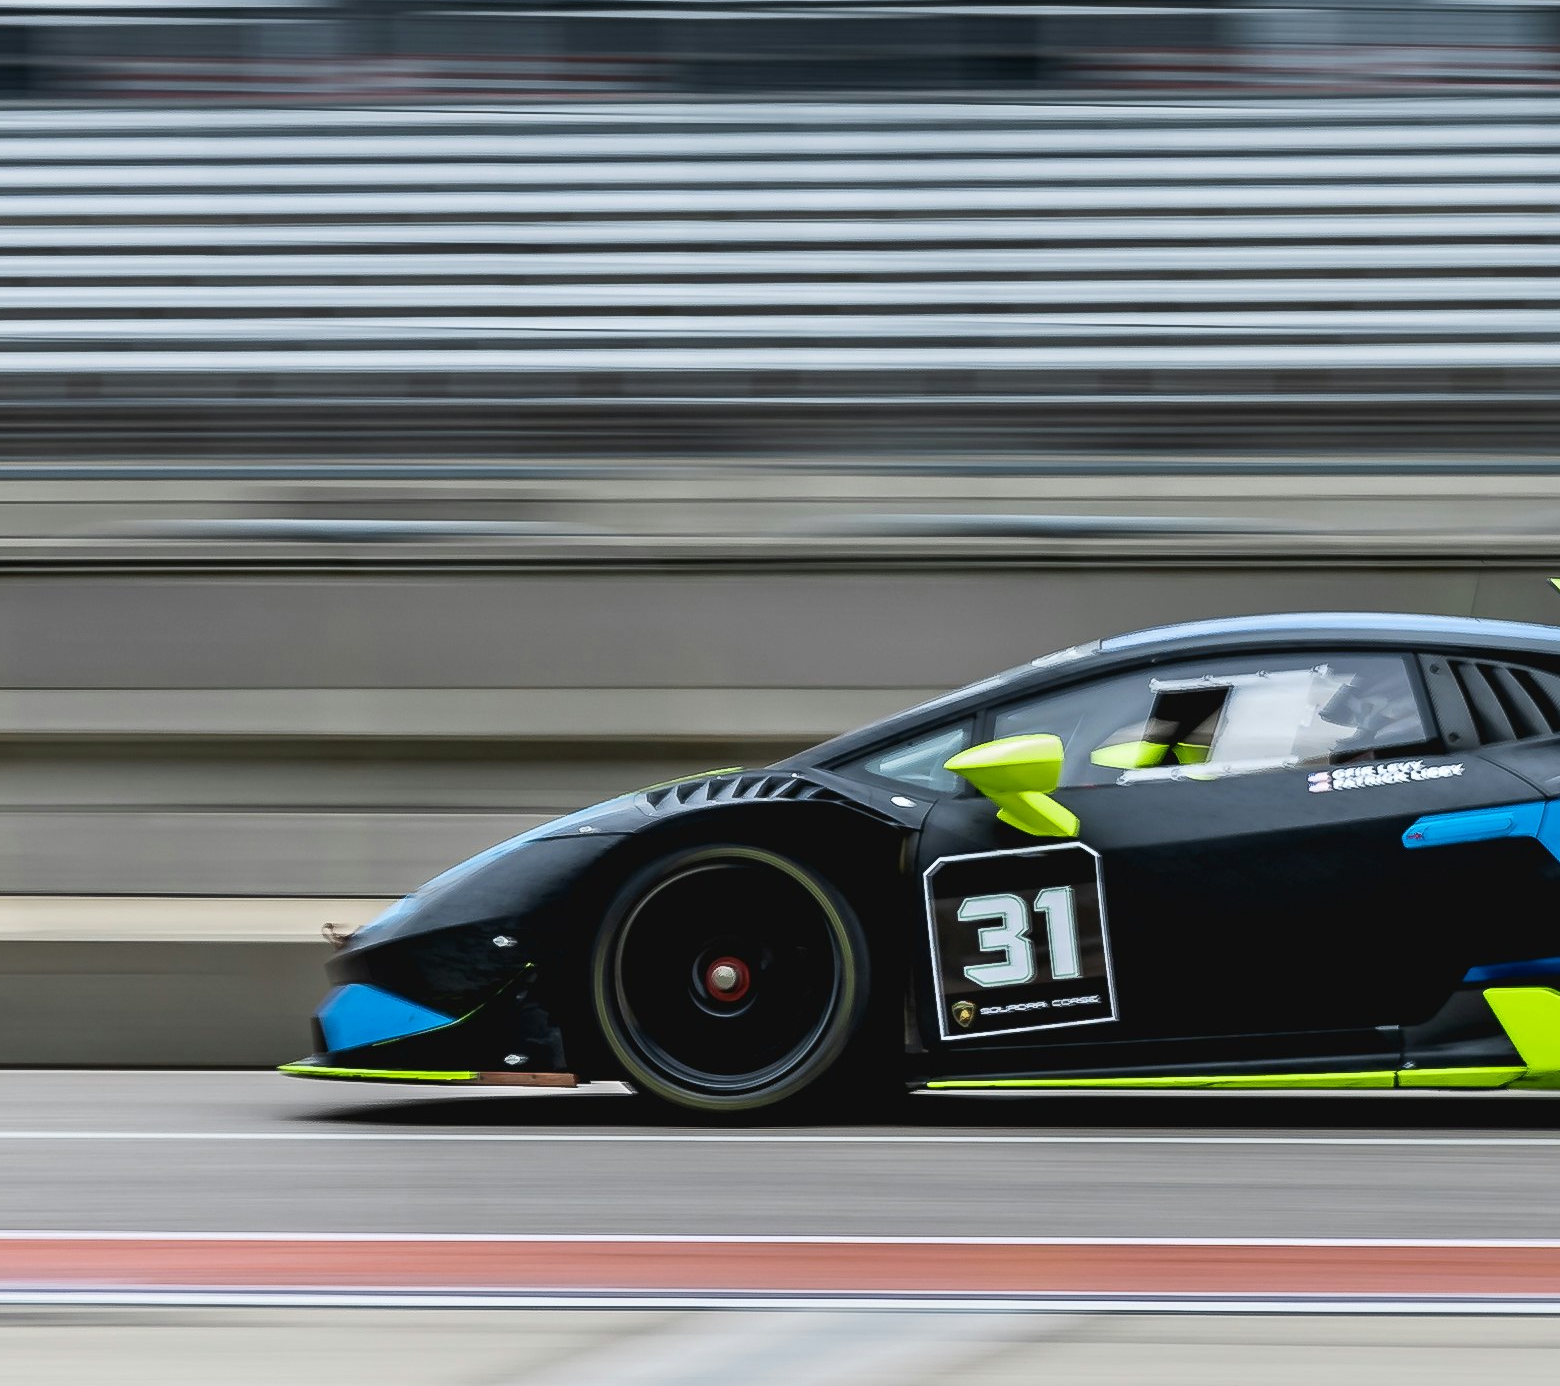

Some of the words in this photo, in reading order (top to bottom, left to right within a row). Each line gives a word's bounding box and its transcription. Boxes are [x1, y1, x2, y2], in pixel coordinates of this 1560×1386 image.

[1332, 771, 1411, 791] PATRICK
[957, 885, 1083, 988] 31
[1051, 994, 1102, 1007] CORSE
